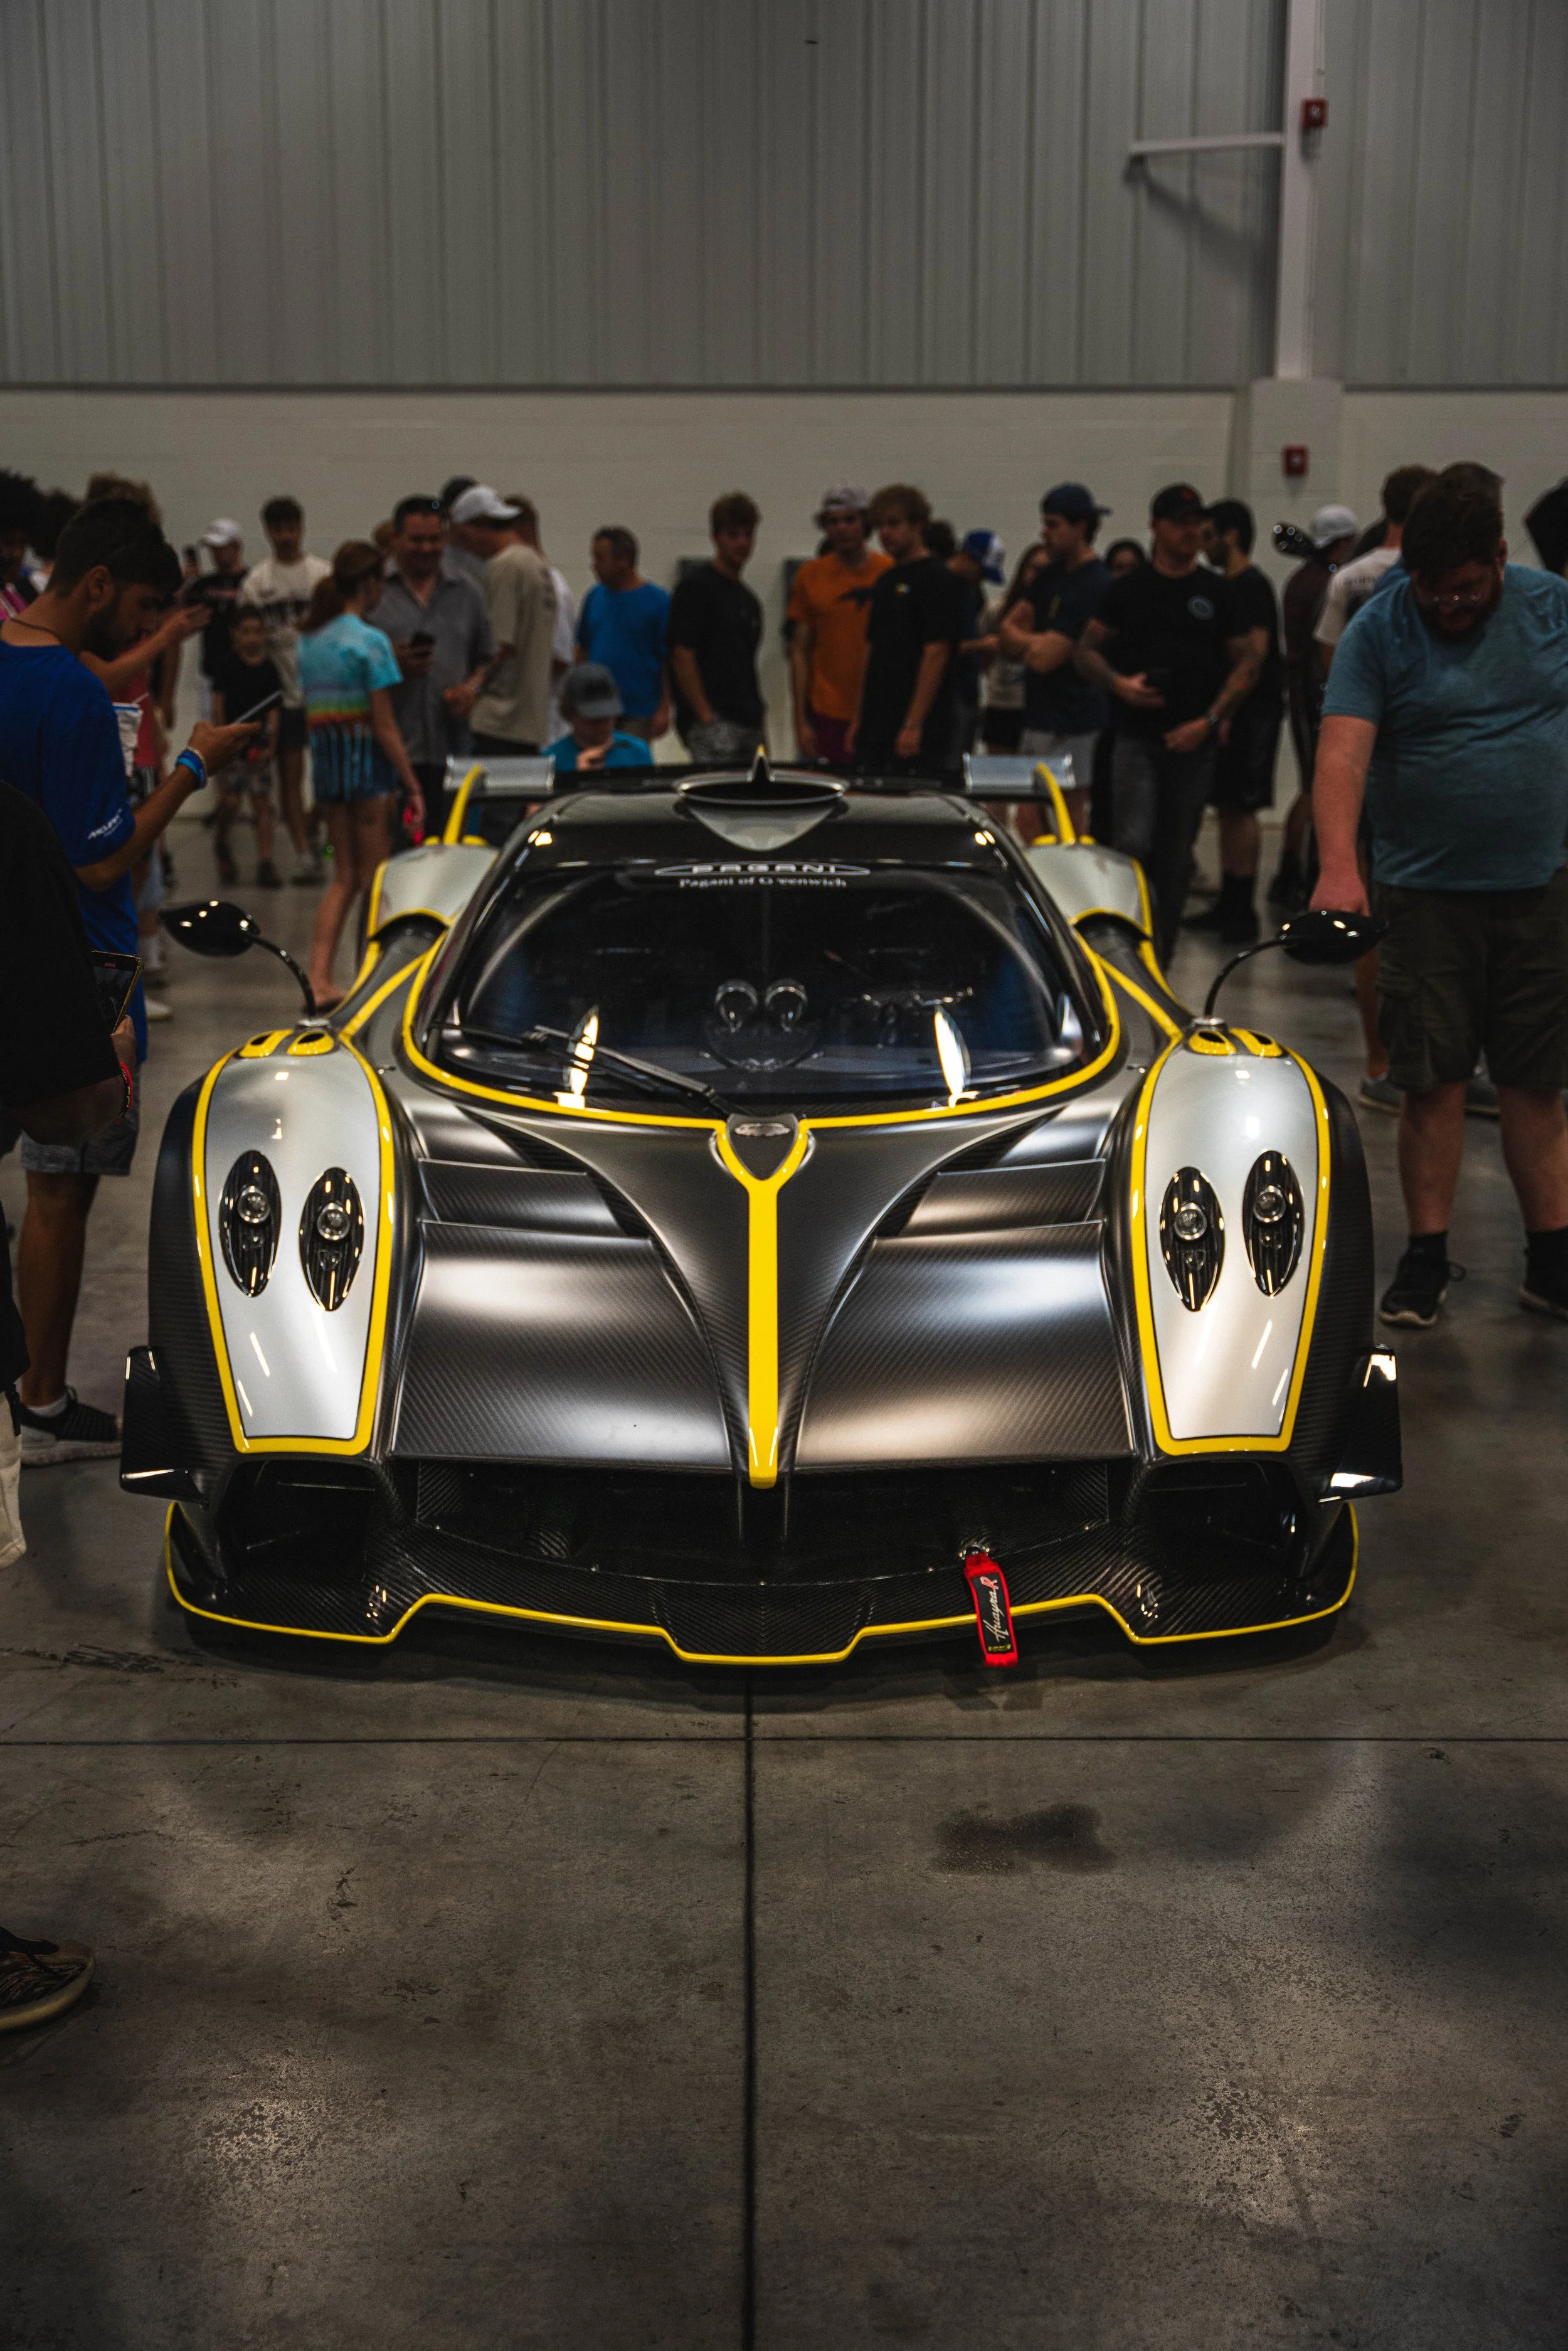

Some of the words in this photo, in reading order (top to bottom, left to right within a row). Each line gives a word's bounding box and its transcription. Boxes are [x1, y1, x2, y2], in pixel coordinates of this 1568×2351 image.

[680, 878, 733, 888] Pagani
[738, 876, 755, 885] of
[759, 877, 846, 888] Geenwich
